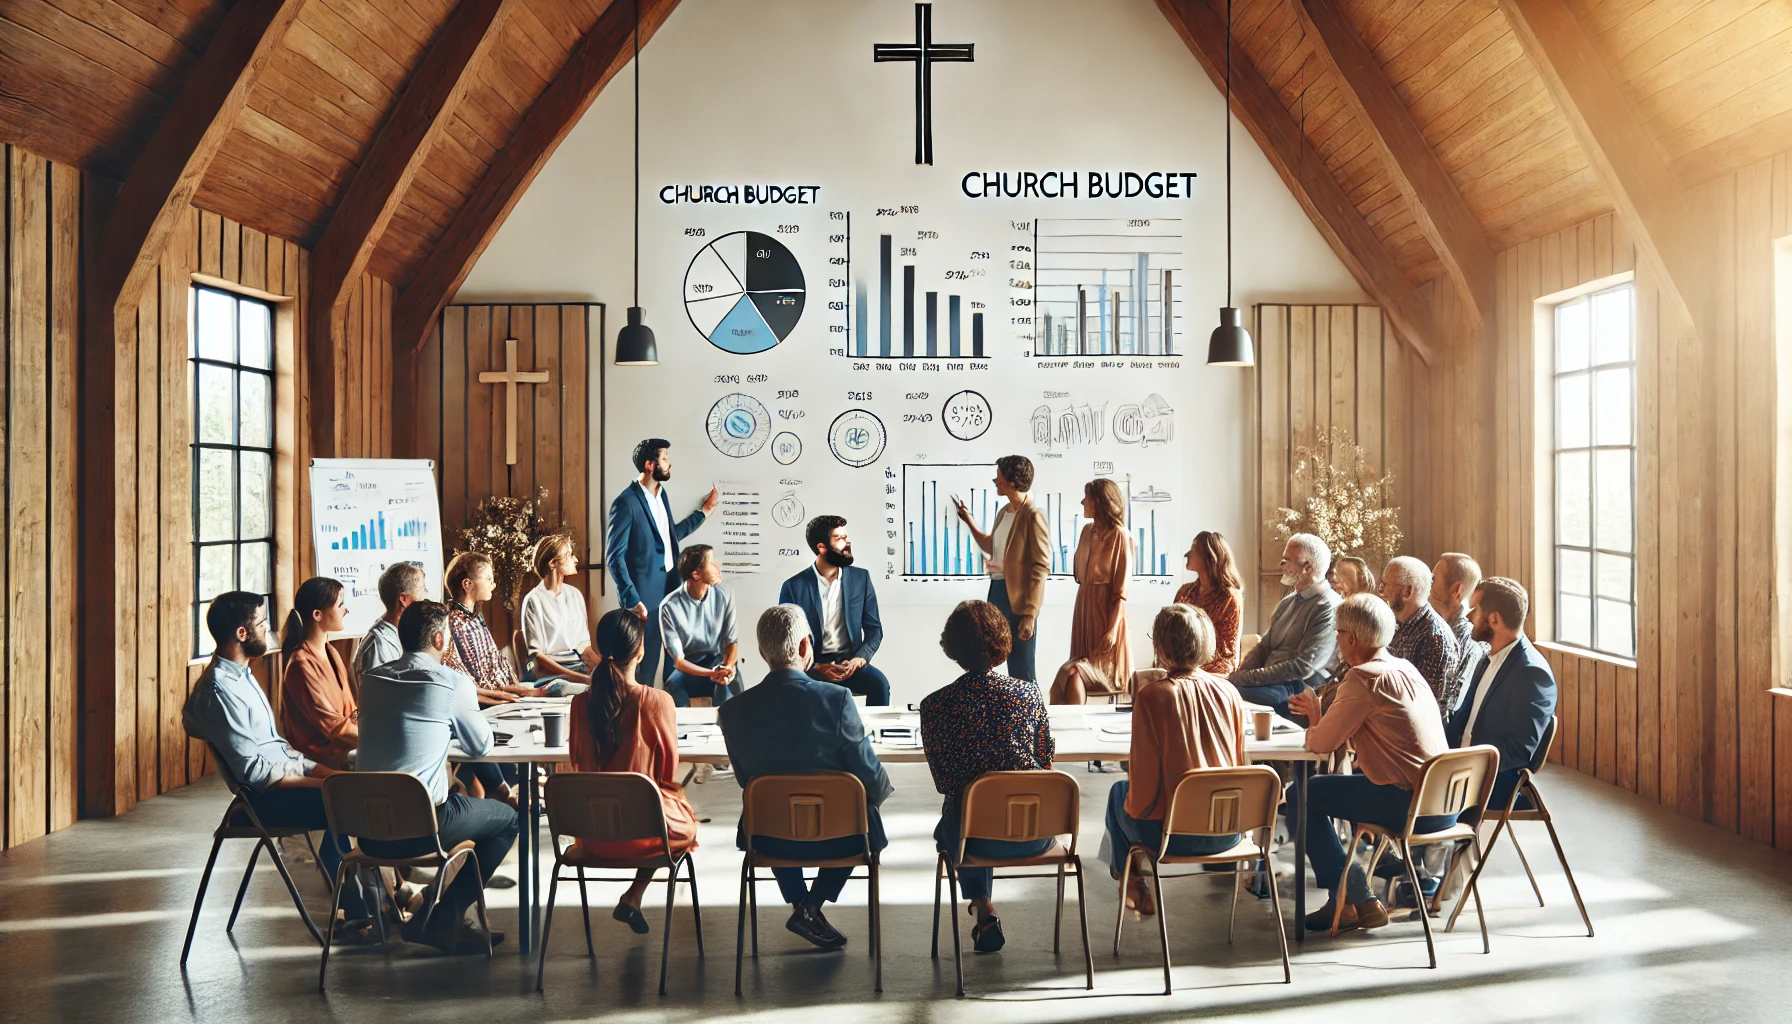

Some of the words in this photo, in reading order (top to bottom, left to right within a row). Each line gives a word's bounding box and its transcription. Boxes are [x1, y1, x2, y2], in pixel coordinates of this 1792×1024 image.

[659, 184, 739, 204] CHURCH
[743, 184, 821, 204] BUDGET
[961, 171, 1078, 199] CHURCH
[1087, 171, 1197, 199] BUDGET
